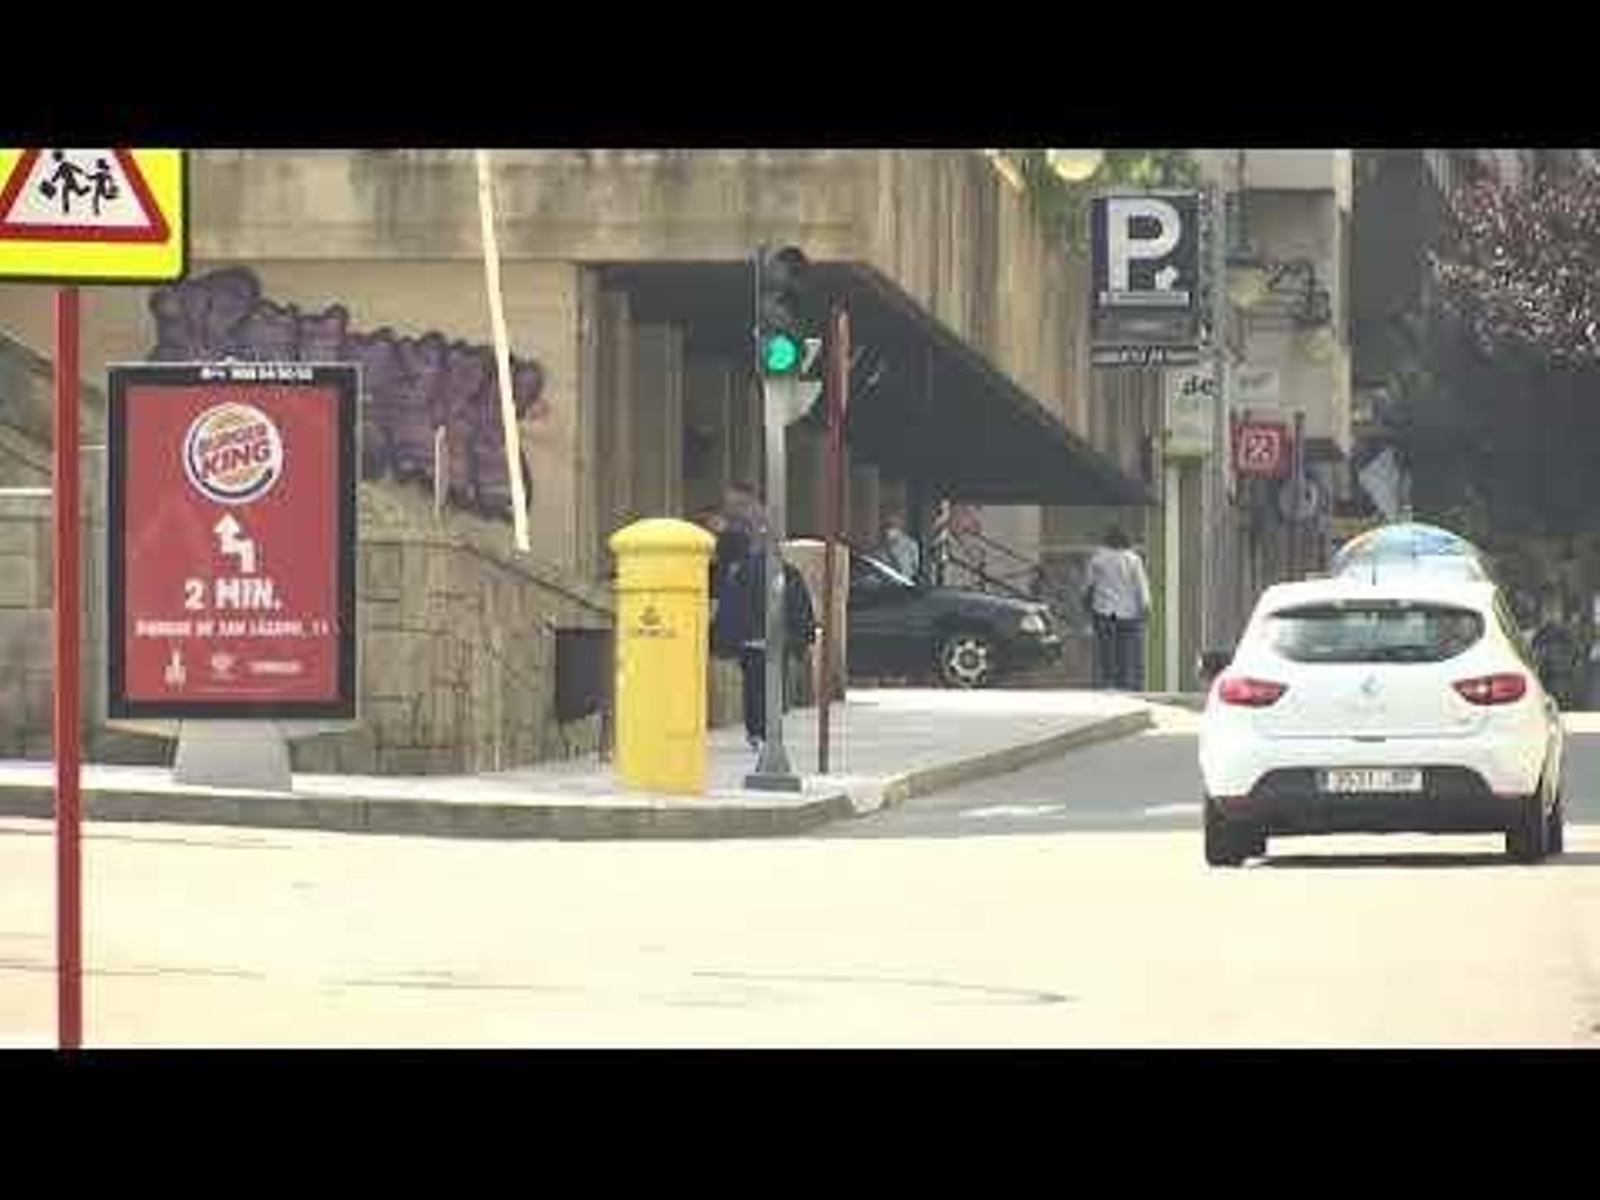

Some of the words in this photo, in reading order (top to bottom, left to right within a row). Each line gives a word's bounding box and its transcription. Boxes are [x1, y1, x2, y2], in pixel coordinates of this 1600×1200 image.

[1108, 197, 1181, 292] P
[202, 441, 272, 480] KING
[184, 579, 205, 610] 2
[214, 577, 283, 612] MIN.
